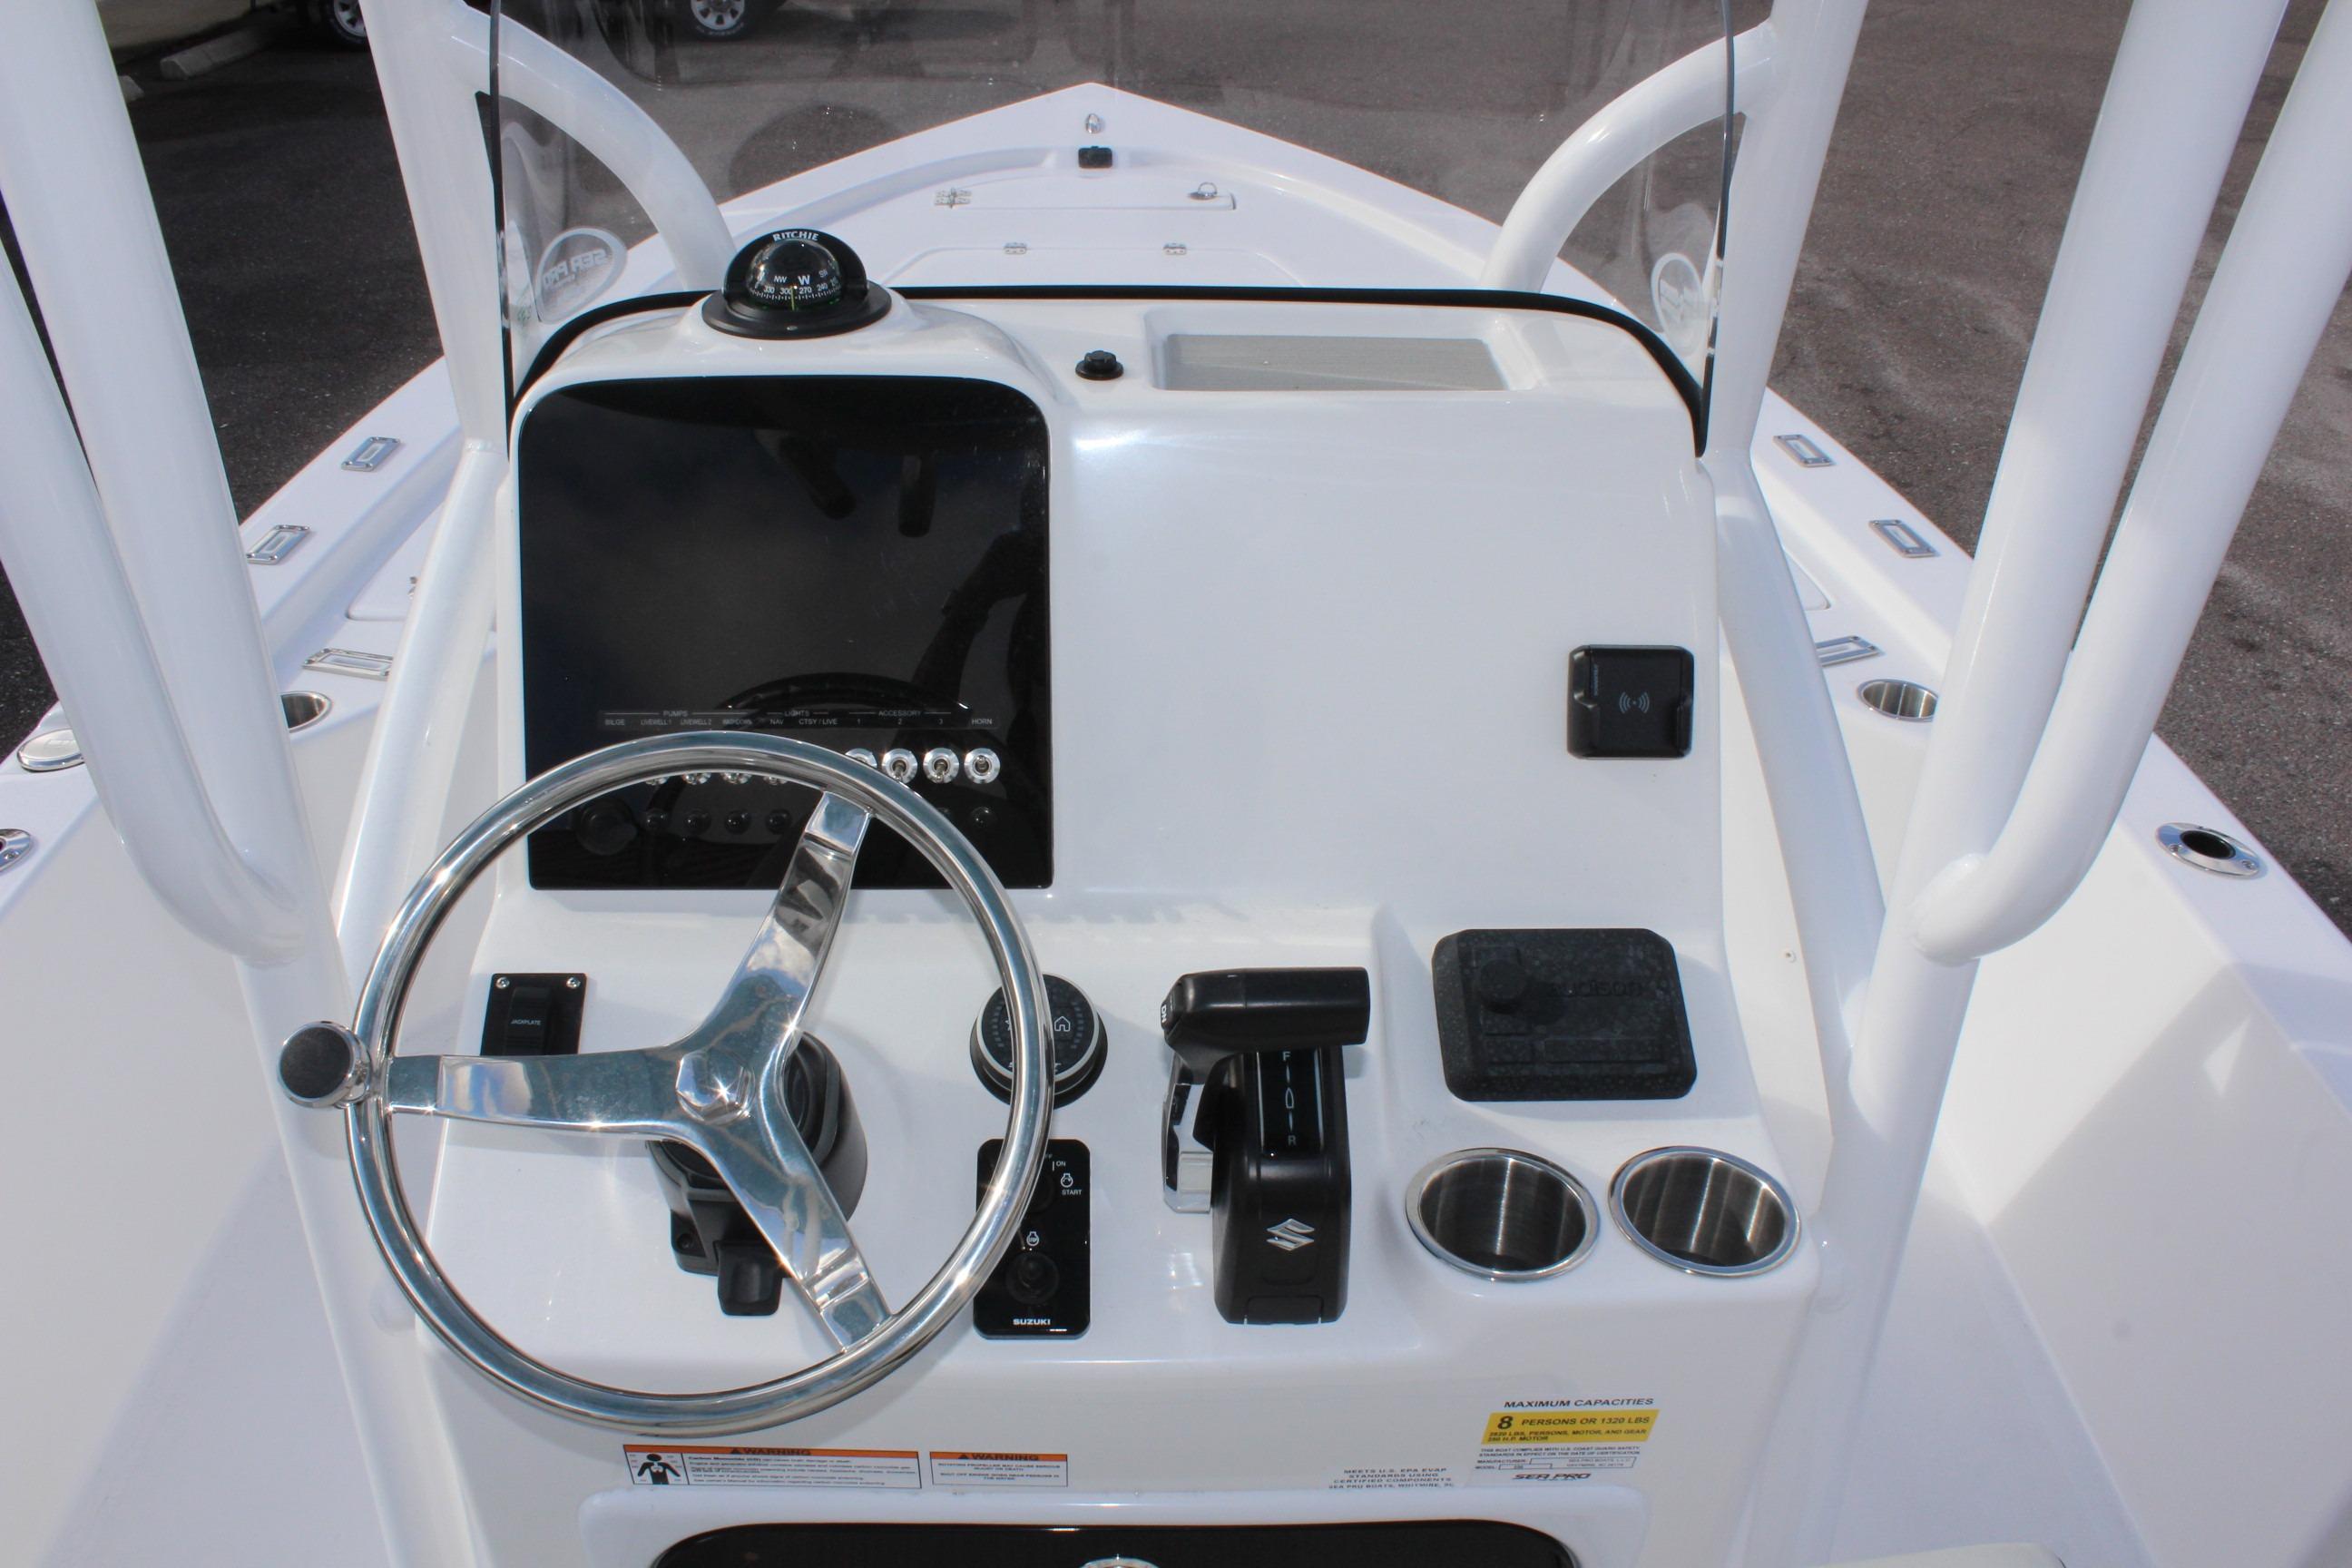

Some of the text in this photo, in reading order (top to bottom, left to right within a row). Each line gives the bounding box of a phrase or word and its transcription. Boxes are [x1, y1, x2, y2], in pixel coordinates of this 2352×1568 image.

[772, 230, 818, 241] RITCHIE
[774, 275, 788, 283] NW
[798, 275, 810, 285] W
[764, 285, 775, 294] 330
[799, 287, 811, 295] 270
[817, 283, 828, 291] 240
[510, 1018, 542, 1026] JACKPLATE
[1282, 1051, 1291, 1061] F
[1288, 1135, 1297, 1145] R
[1573, 1398, 1654, 1406] CAPACITIES
[1497, 1416, 1514, 1429] 8
[1521, 1417, 1577, 1426] PERSONS
[744, 1447, 812, 1456] WARNING
[972, 1453, 1039, 1461] WARNING
[1551, 1473, 1592, 1481] PRO
